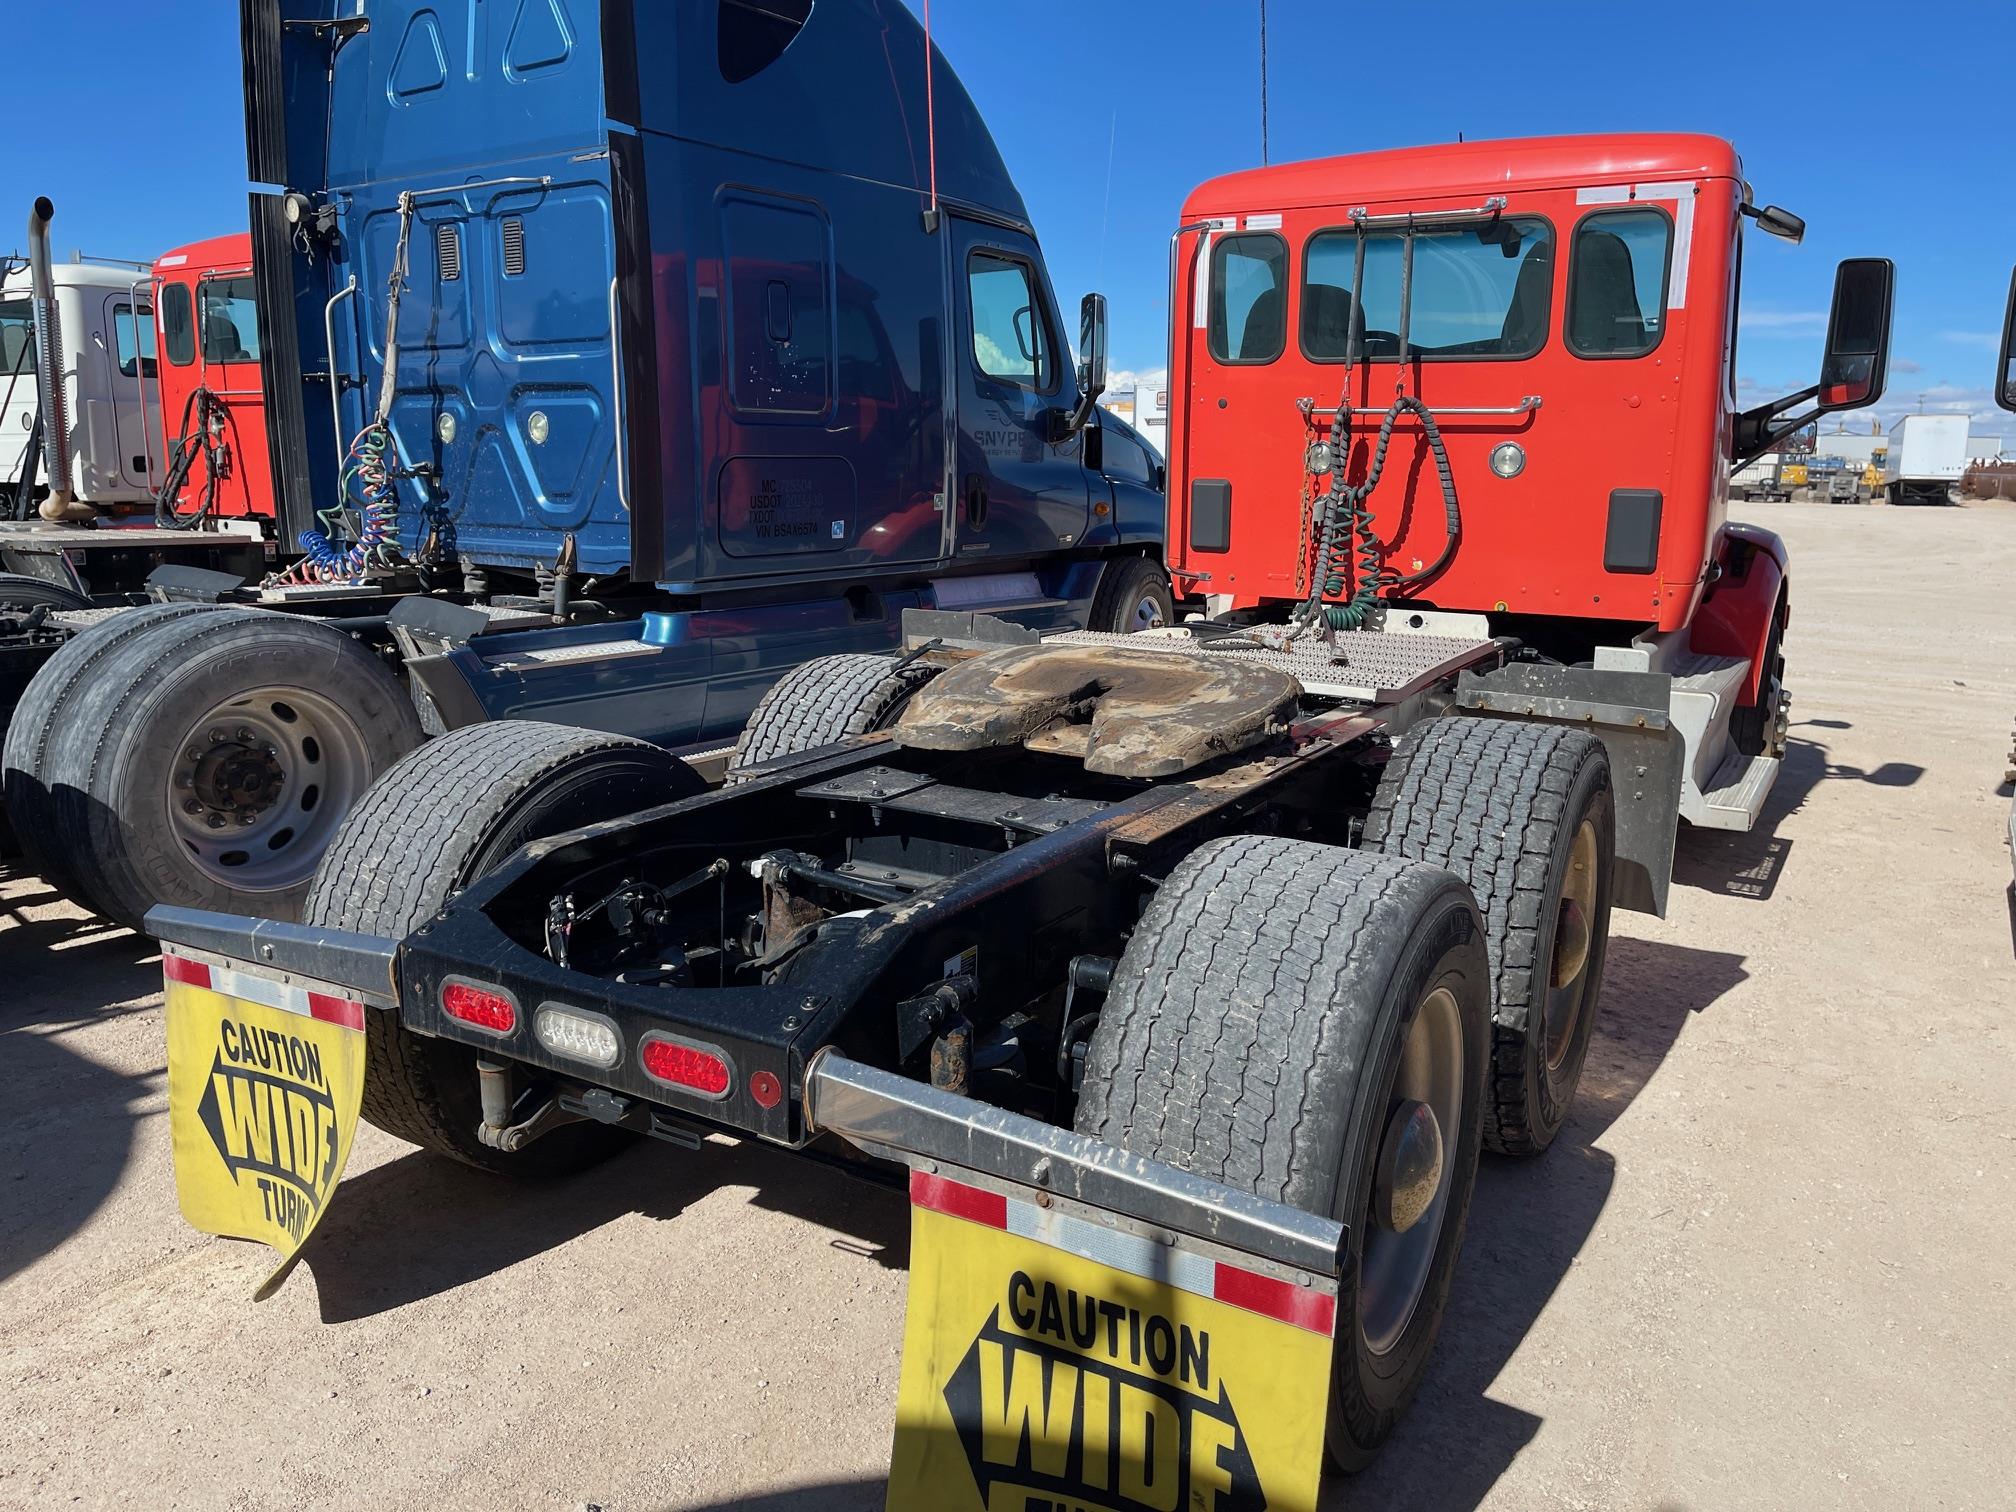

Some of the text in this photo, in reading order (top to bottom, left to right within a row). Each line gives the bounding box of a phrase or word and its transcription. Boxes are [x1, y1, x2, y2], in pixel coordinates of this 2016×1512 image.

[750, 494, 782, 509] USDOT
[761, 479, 777, 493] MC
[748, 509, 775, 524] TXDOT
[756, 525, 771, 538] VIN
[221, 1018, 323, 1088] CAUTION
[212, 1072, 334, 1202] WIDE
[1008, 1270, 1209, 1391] CAUTION
[978, 1338, 1236, 1512] WIDE
